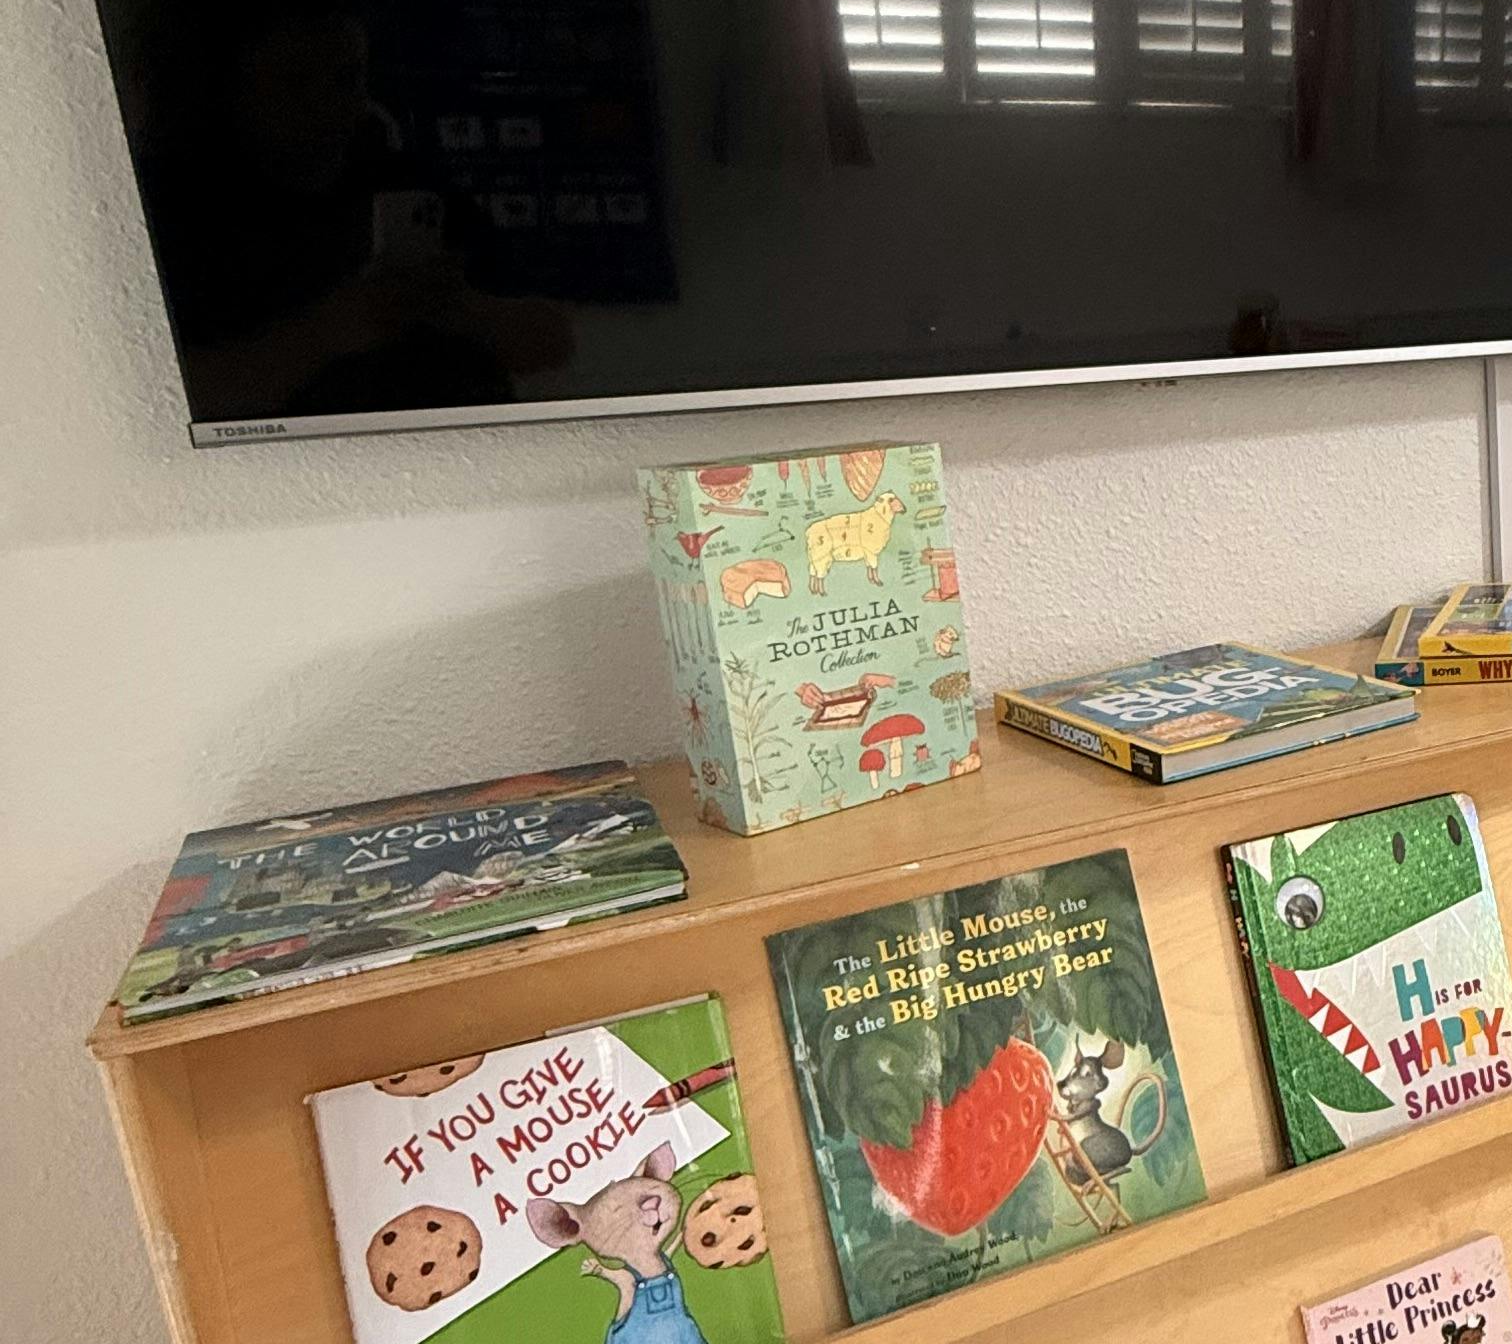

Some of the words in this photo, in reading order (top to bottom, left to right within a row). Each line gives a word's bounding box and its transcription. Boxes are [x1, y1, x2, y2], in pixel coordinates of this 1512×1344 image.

[213, 424, 287, 437] TOSHIBA
[767, 615, 920, 663] ROTHMAN
[787, 616, 809, 637] The
[813, 598, 902, 632] JULIA
[819, 648, 880, 674] Collection
[1092, 657, 1250, 698] ULTIMATE
[1431, 667, 1461, 677] BOYER
[1119, 674, 1320, 722] OPEDIA
[1009, 704, 1051, 732] ULTIMATE
[1045, 717, 1106, 755] BUGOPEDIA
[216, 840, 319, 871] THE
[475, 829, 552, 857] ME
[833, 953, 873, 976] The
[876, 927, 955, 966] Little
[960, 902, 1058, 939] Mouse,
[1059, 896, 1088, 915] the
[822, 975, 881, 1012] Red
[886, 953, 952, 995] Ripe
[956, 915, 1109, 974] Strawberry
[833, 1024, 851, 1042] &
[855, 1013, 887, 1035] the
[889, 992, 938, 1025] Big
[944, 964, 1046, 1010] Hungry
[1052, 944, 1115, 979] Bear
[1391, 958, 1435, 1022] H
[1434, 989, 1449, 1005] IS
[1455, 978, 1482, 999] FOR
[1404, 1059, 1512, 1120] SAURUS
[384, 1134, 426, 1184] IF
[428, 1092, 496, 1155] YOU
[499, 1046, 585, 1112] GIVE
[470, 1152, 495, 1188] A
[495, 1077, 617, 1165] MOUSE
[492, 1192, 519, 1226] A
[526, 1100, 647, 1197] COOKIE
[1385, 1268, 1442, 1311] Dear
[1403, 1277, 1496, 1336] Princess
